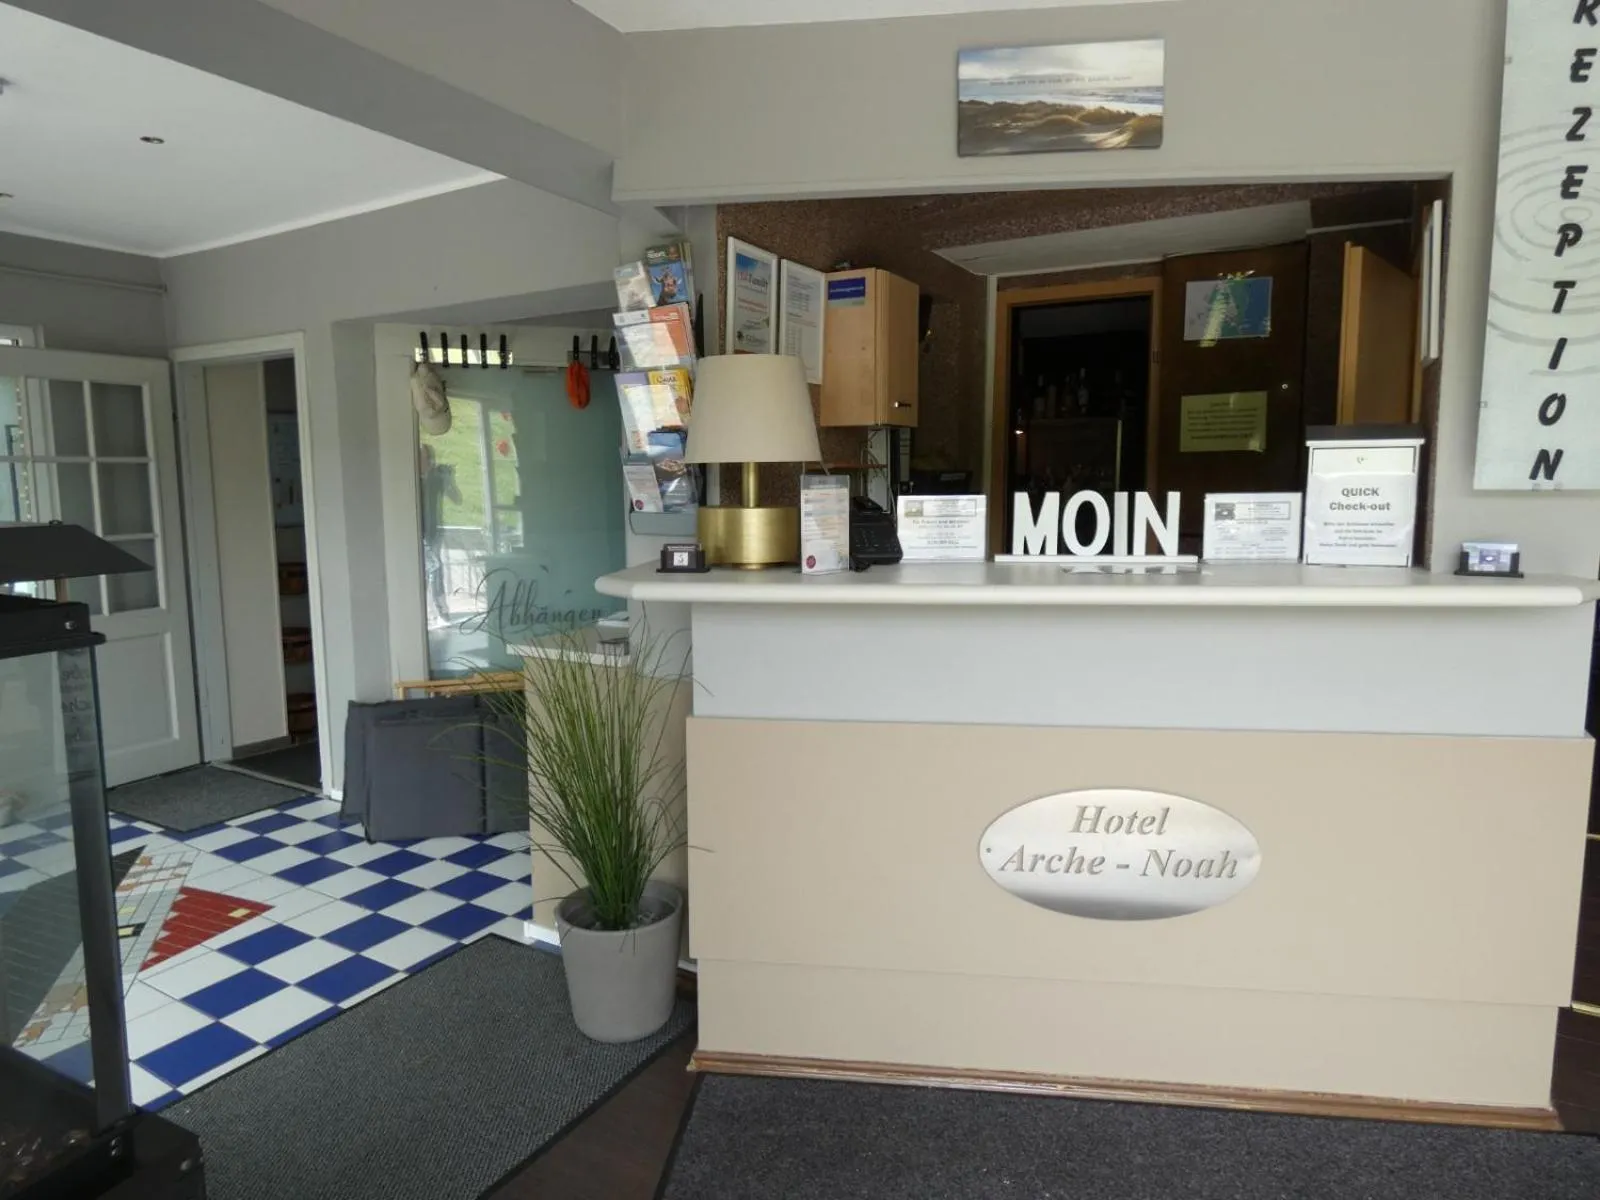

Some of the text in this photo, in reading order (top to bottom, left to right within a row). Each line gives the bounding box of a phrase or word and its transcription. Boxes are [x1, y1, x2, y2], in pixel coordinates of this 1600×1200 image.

[1329, 501, 1391, 511] Check-out
[1341, 487, 1380, 497] QUICK
[1012, 489, 1181, 556] MOIN
[459, 567, 602, 637] Abhängen
[1070, 805, 1170, 836] Hotel
[998, 844, 1106, 875] Arche
[1140, 849, 1239, 879] Noah
